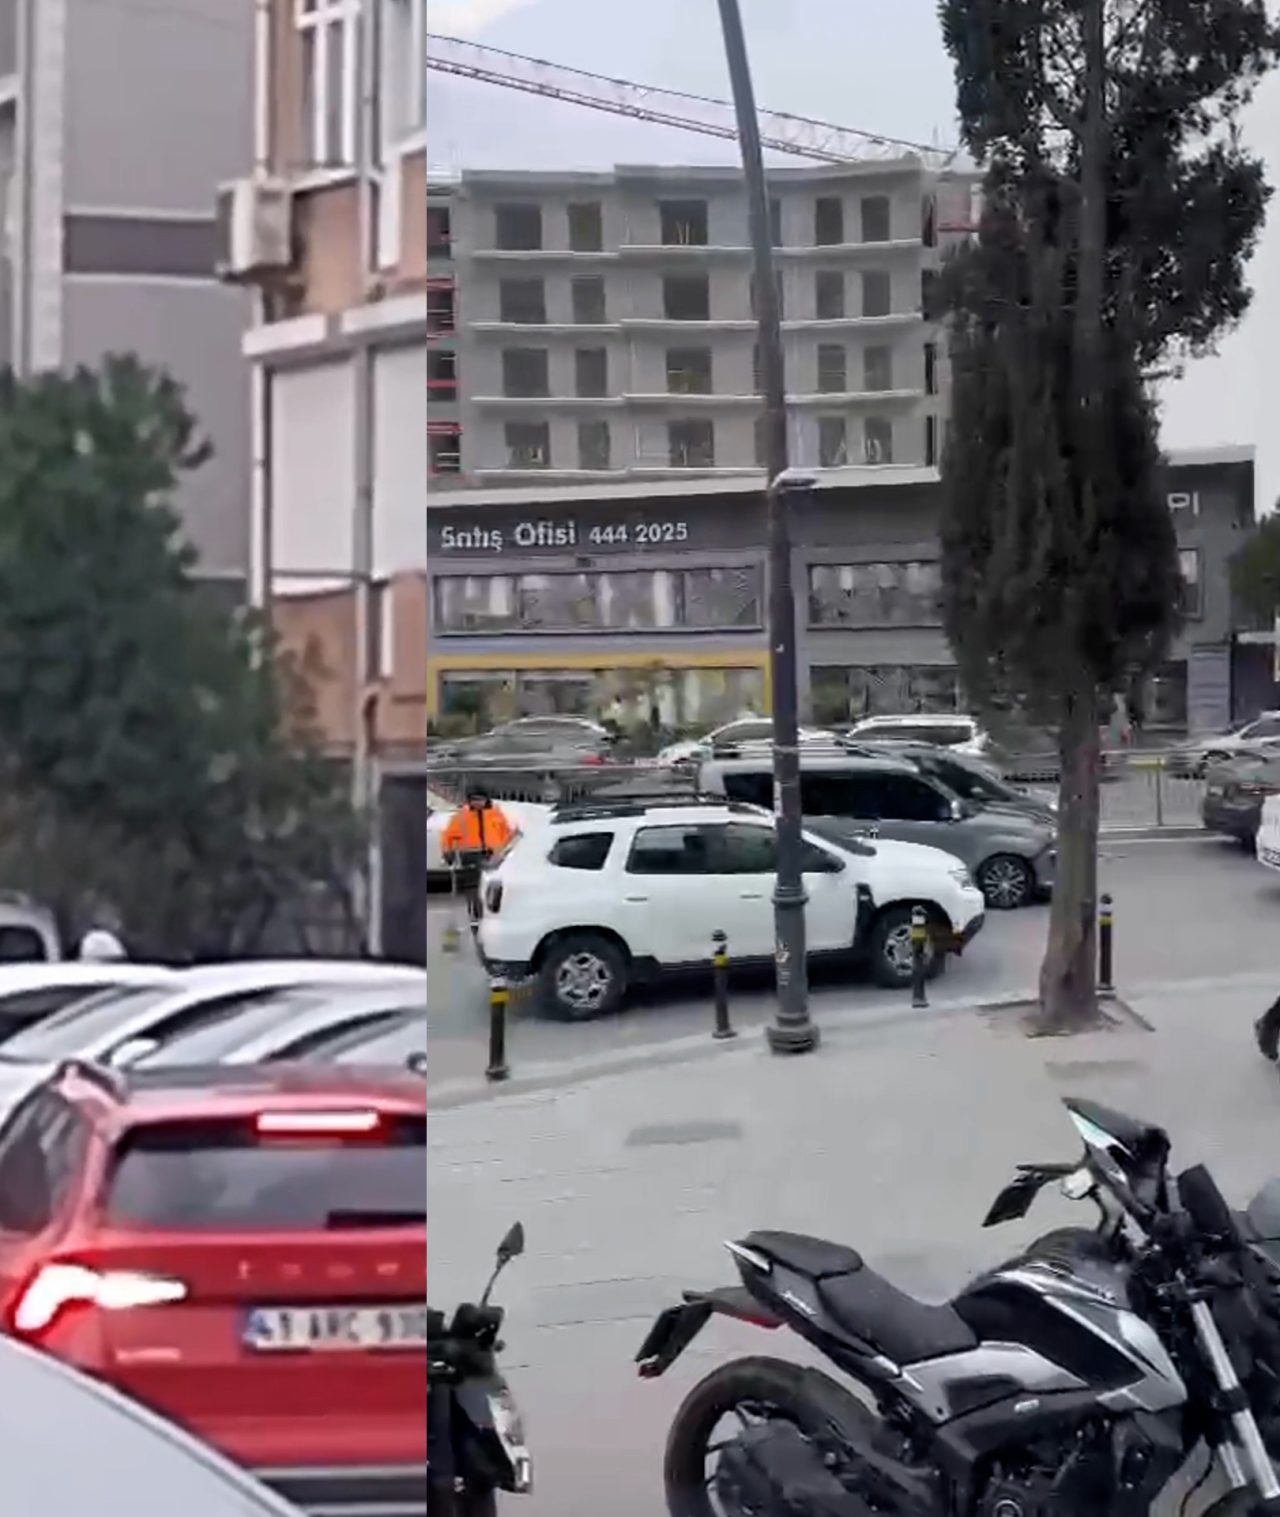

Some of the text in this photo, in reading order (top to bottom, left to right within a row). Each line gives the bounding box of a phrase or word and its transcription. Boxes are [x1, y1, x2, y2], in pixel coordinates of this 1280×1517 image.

[514, 520, 576, 546] Ofisi
[588, 523, 629, 545] 444
[635, 521, 689, 543] 2025
